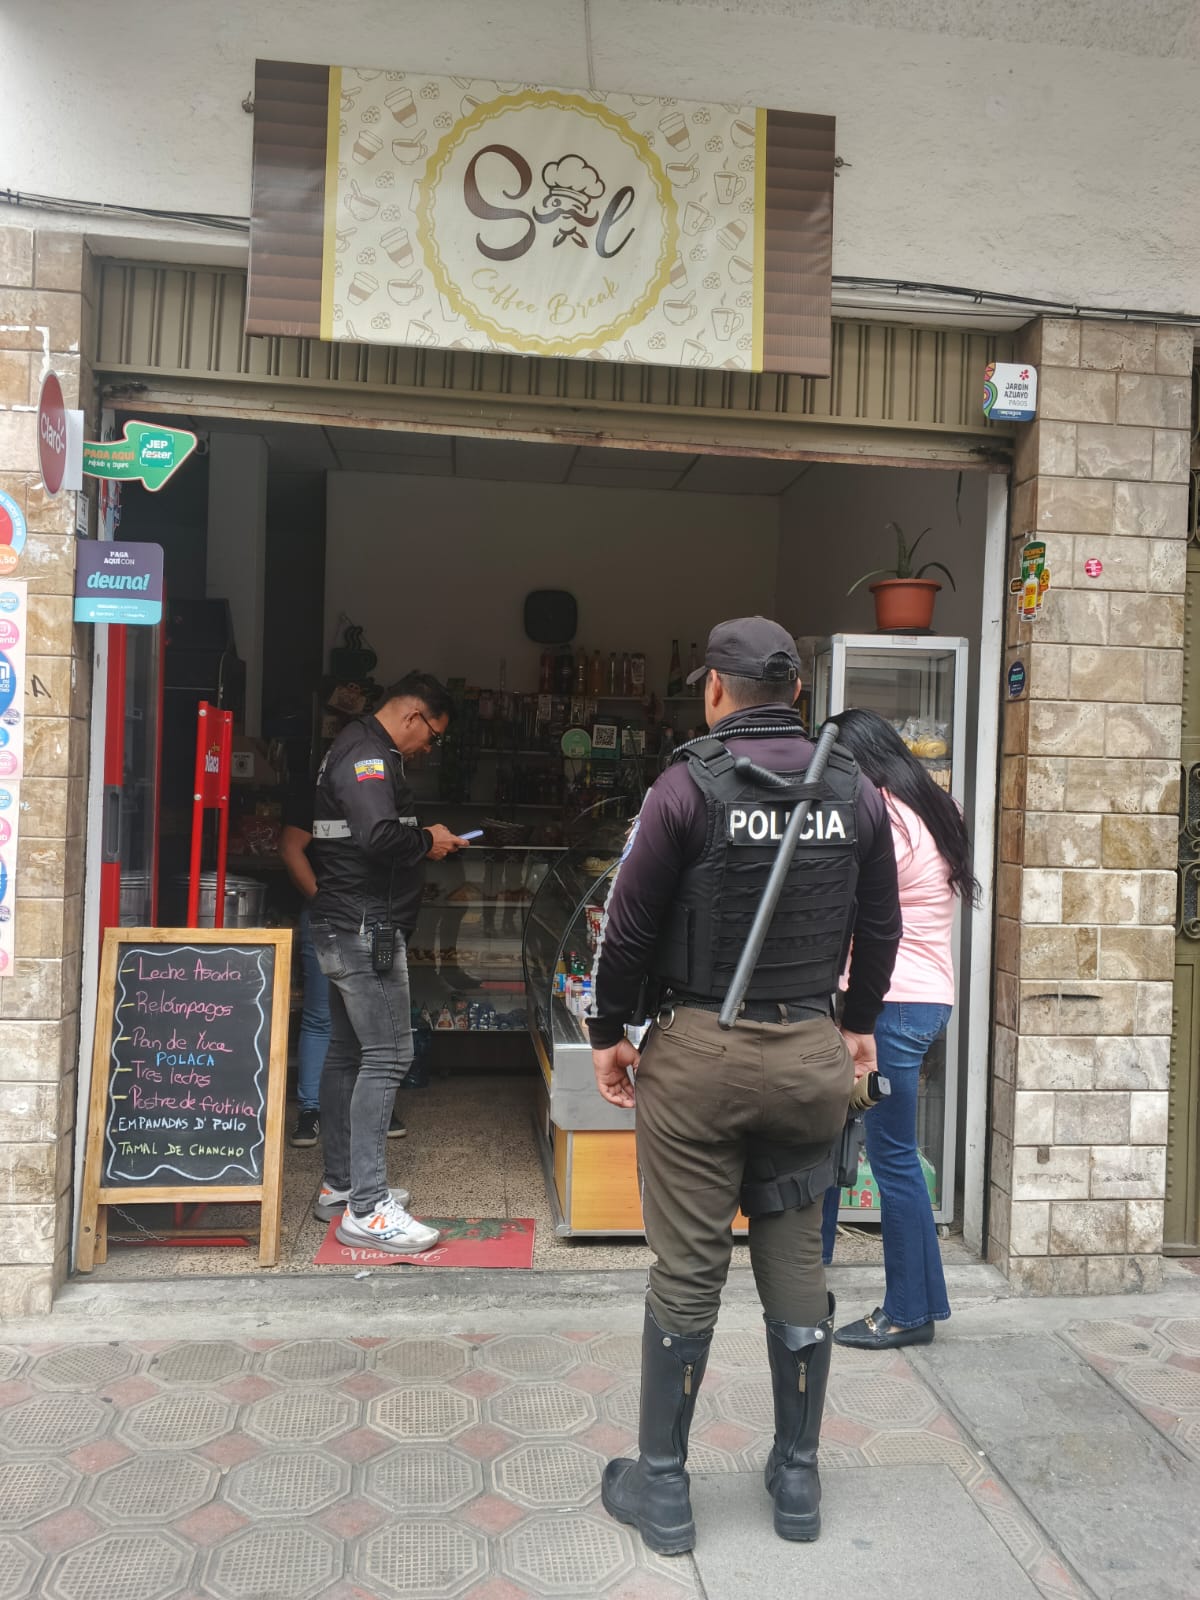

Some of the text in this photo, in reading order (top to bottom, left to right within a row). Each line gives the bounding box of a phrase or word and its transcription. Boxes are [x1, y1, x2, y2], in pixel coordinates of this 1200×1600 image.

[471, 268, 620, 325] Coffee Break
[1004, 391, 1029, 399] AZUAYO
[41, 412, 62, 455] Claro
[146, 439, 168, 449] JEP
[142, 448, 173, 459] faster
[87, 571, 151, 591] deuna!
[138, 957, 241, 981] Leche Asada
[132, 1026, 162, 1050] Pan
[166, 1028, 188, 1050] de
[155, 1051, 216, 1067] POLACA
[131, 1060, 212, 1088] Tres leches
[118, 1116, 189, 1132] EMPANADAS
[212, 1117, 247, 1131] Pollo
[118, 1141, 245, 1157] TAMAL DE CHANCHO
